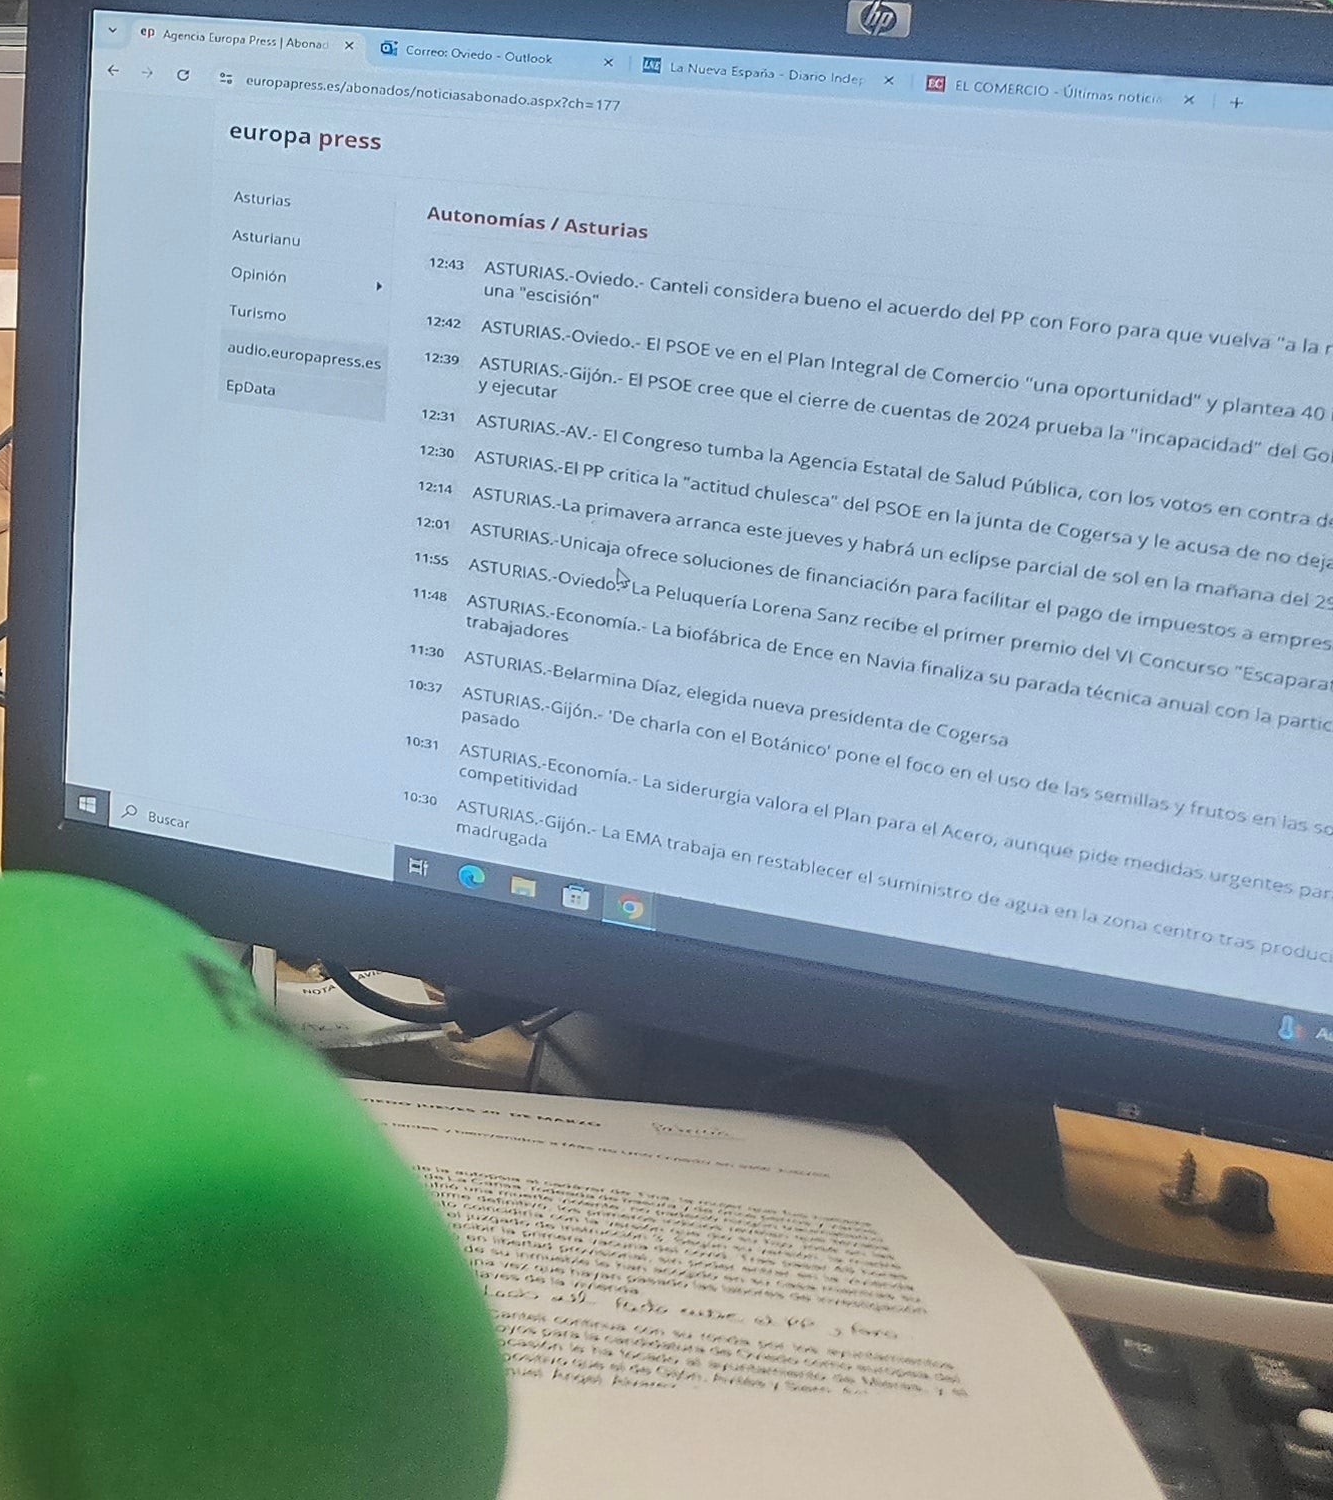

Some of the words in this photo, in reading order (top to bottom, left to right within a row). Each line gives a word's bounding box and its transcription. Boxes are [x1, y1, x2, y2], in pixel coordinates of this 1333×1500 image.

[863, 0, 895, 37] hp
[140, 26, 155, 39] ep
[163, 28, 205, 43] Agencia
[209, 32, 245, 46] Europa
[249, 35, 277, 47] Press
[405, 44, 448, 57] Correo:
[450, 47, 492, 60] Oviedo
[504, 50, 552, 64] Outlook
[670, 62, 683, 73] La
[688, 63, 727, 77] Nueva
[731, 65, 775, 80] España
[789, 68, 827, 82] Diario
[245, 77, 620, 111] europapress.es/abonados/noticiasabonado.aspx?ch=177
[955, 79, 969, 92] EL
[974, 82, 1049, 97] COMERCIO
[1064, 84, 1114, 102] Últimas
[229, 125, 311, 148] europa
[318, 132, 381, 151] press
[233, 190, 291, 207] Asturias
[426, 205, 545, 230] Autonomías
[563, 218, 648, 239] Asturias
[231, 229, 300, 247] Asturianu
[428, 256, 464, 270] 12:43
[230, 265, 286, 283] Opinión
[483, 260, 644, 288] ASTURIAS.-Oviedo.-
[649, 276, 708, 295] Canteli
[712, 285, 799, 304] considera
[803, 290, 861, 310] bueno
[866, 297, 882, 312] el
[886, 301, 962, 320] acuerdo
[483, 285, 515, 299] una
[519, 285, 599, 306] "escisión"
[229, 303, 286, 321] Turismo
[426, 315, 461, 329] 12:42
[480, 319, 640, 349] ASTURIAS.-Oviedo.-
[645, 336, 660, 351] El
[665, 338, 710, 356] PSOE
[714, 346, 735, 359] ve
[739, 349, 762, 362] en
[766, 349, 782, 364] el
[227, 342, 381, 370] audio.europapress.es
[424, 351, 460, 365] 12:39
[226, 378, 275, 396] EpData
[477, 379, 488, 394] y
[491, 378, 558, 398] ejecutar
[478, 356, 623, 385] ASTURIAS.-Gijón.-
[628, 372, 643, 387] El
[647, 374, 692, 393] PSOE
[697, 382, 735, 397] cree
[739, 387, 773, 403] que
[420, 407, 455, 422] 12:31
[475, 413, 598, 440] ASTURIAS.-AV.-
[603, 428, 617, 443] El
[621, 430, 702, 453] Congreso
[707, 442, 764, 461] tumba
[768, 447, 784, 463] la
[419, 444, 455, 459] 12:30
[473, 449, 578, 475] ASTURIAS.-El
[582, 462, 604, 478] PP
[608, 467, 659, 485] critica
[663, 472, 678, 488] la
[682, 475, 750, 497] "actitud
[418, 480, 452, 495] 12:14
[416, 515, 450, 531] 12:01
[471, 486, 580, 513] ASTURIAS.-La
[584, 502, 671, 524] primavera
[675, 515, 741, 534] arranca
[745, 524, 782, 540] este
[785, 526, 843, 547] jueves
[414, 551, 449, 567] 11:55
[470, 522, 620, 557] ASTURIAS.-Unicaja
[625, 543, 678, 563] ofrece
[682, 552, 774, 576] soluciones
[778, 563, 800, 580] de
[805, 566, 911, 595] financiación
[412, 587, 447, 602] 11:48
[632, 580, 650, 597] La
[655, 584, 747, 610] Peluquería
[751, 597, 812, 619] Lorena
[465, 593, 647, 632] ASTURIAS.-Economía.-
[651, 620, 671, 637] La
[676, 623, 761, 650] biofábrica
[766, 637, 788, 654] de
[792, 641, 834, 661] Ence
[466, 615, 569, 642] trabajadores
[409, 643, 445, 658] 11:30
[408, 678, 443, 694] 10:37
[463, 650, 636, 689] ASTURIAS.-Belarmina
[641, 677, 681, 698] Díaz,
[686, 685, 747, 707] elegida
[752, 697, 804, 716] nueva
[808, 706, 903, 731] presidenta
[908, 718, 931, 735] de
[935, 723, 1009, 747] Cogersa
[461, 686, 603, 720] ASTURIAS.-Gijón.-
[608, 709, 635, 726] 'De
[639, 714, 690, 735] charla
[695, 726, 726, 741] con
[461, 710, 520, 729] pasado
[405, 735, 438, 751] 10:31
[458, 766, 577, 797] competitividad
[459, 743, 638, 784] ASTURIAS.-Economía.-
[642, 773, 661, 789] La
[666, 778, 750, 806] siderurgia
[755, 794, 809, 814] valora
[402, 790, 438, 807] 10:30
[147, 811, 190, 829] Buscar
[456, 799, 596, 835] ASTURIAS.-Gijón.-
[601, 824, 620, 840] La
[625, 828, 662, 848] EMA
[666, 837, 726, 861] trabaja
[455, 822, 547, 848] madrugada
[303, 984, 337, 995] NOTA
